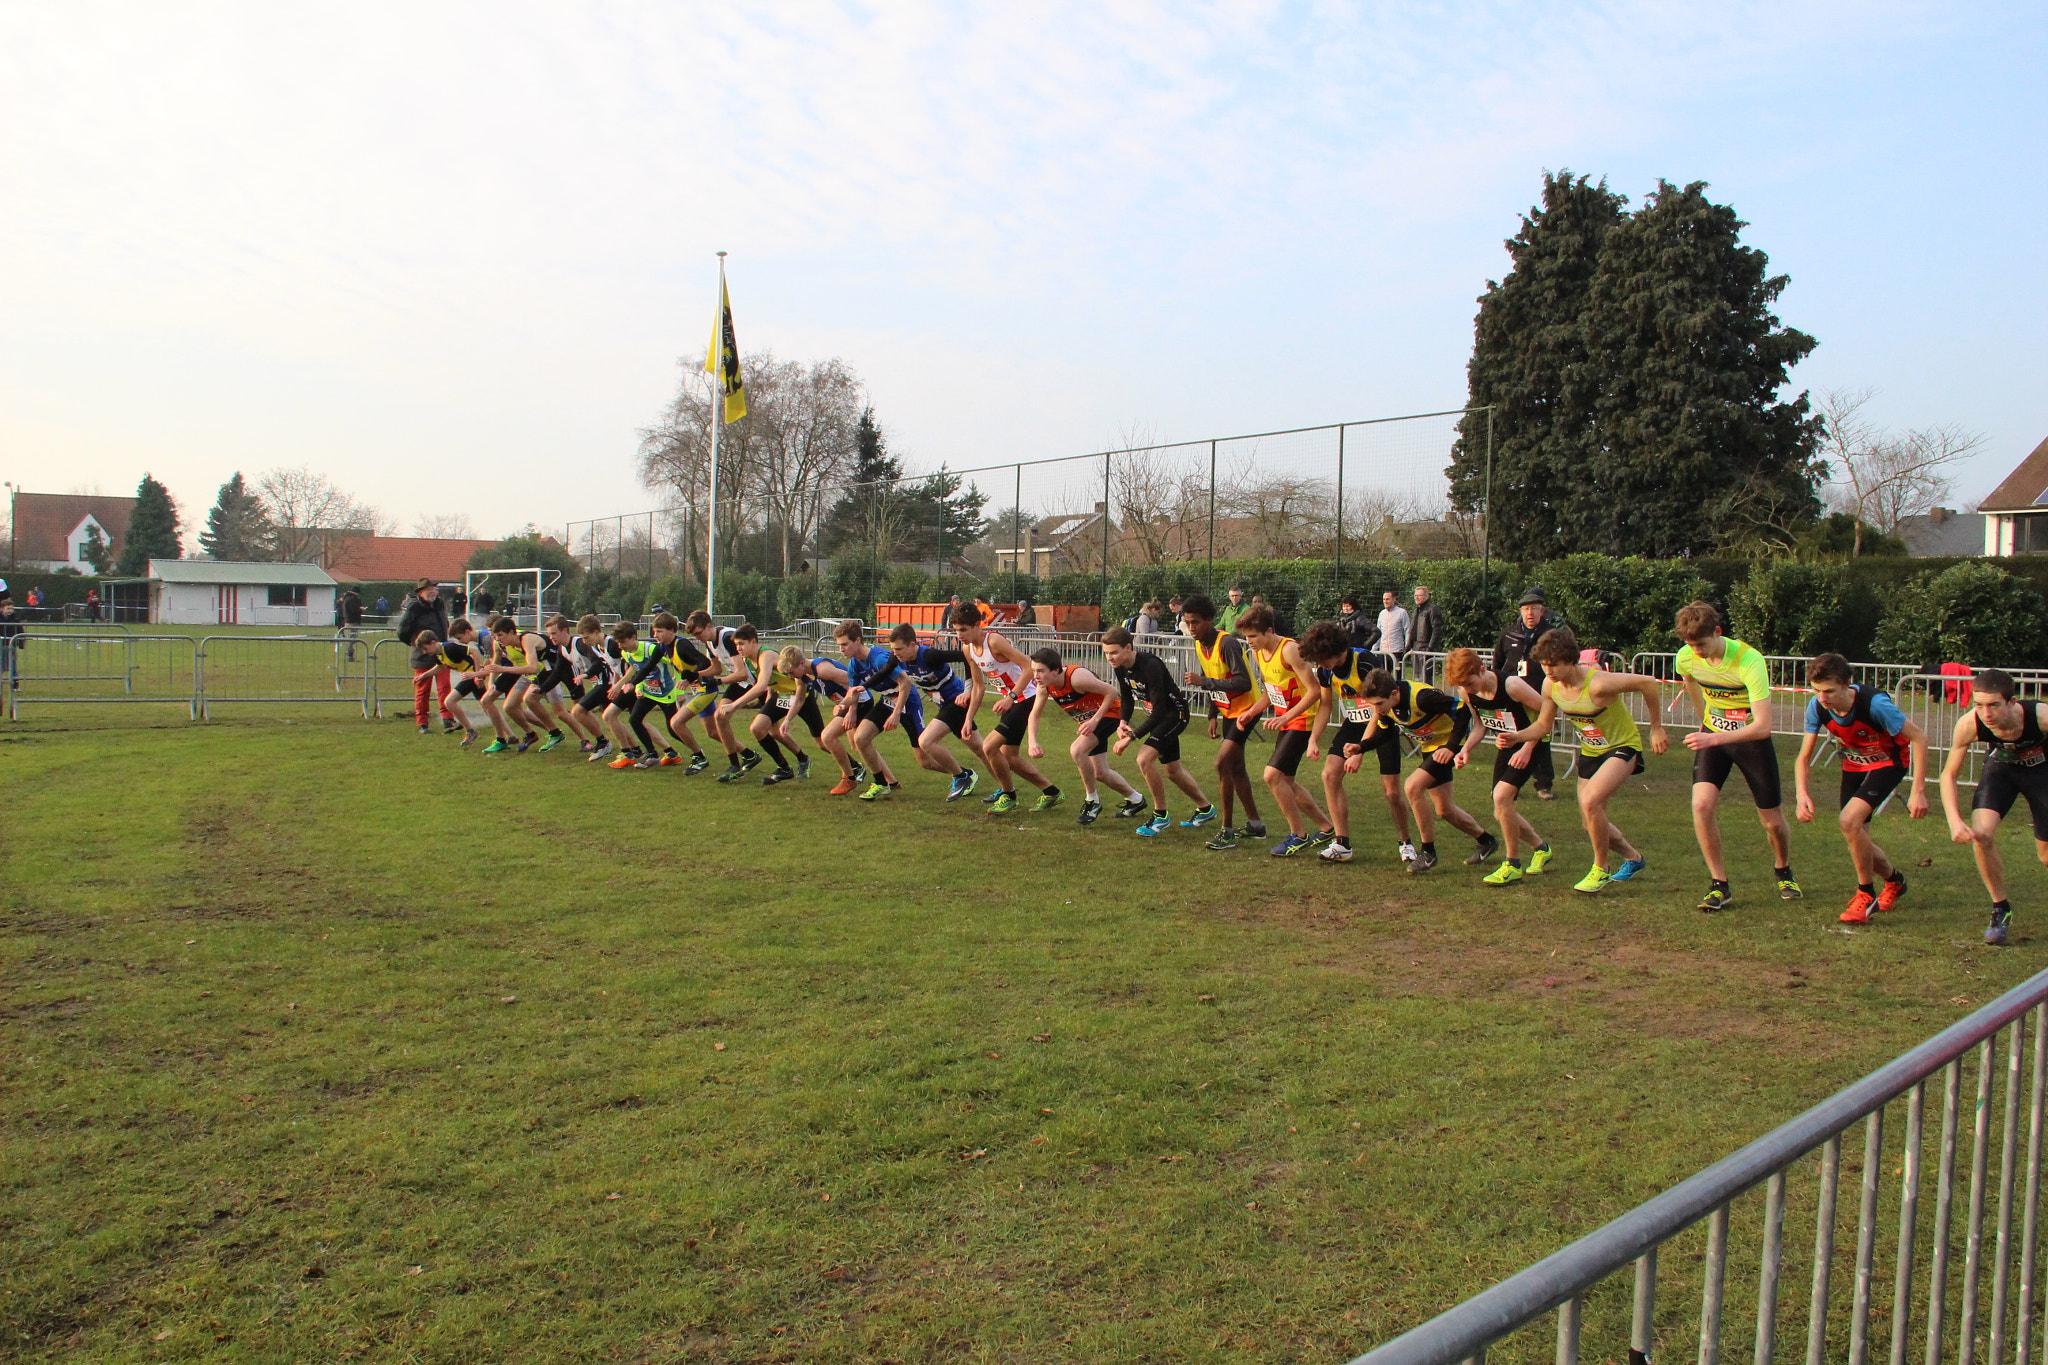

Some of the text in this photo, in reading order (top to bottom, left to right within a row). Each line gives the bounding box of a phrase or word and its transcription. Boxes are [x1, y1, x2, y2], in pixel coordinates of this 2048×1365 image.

[1347, 709, 1370, 721] 2718
[1711, 715, 1739, 730] 2328
[1847, 753, 1880, 764] 2410
